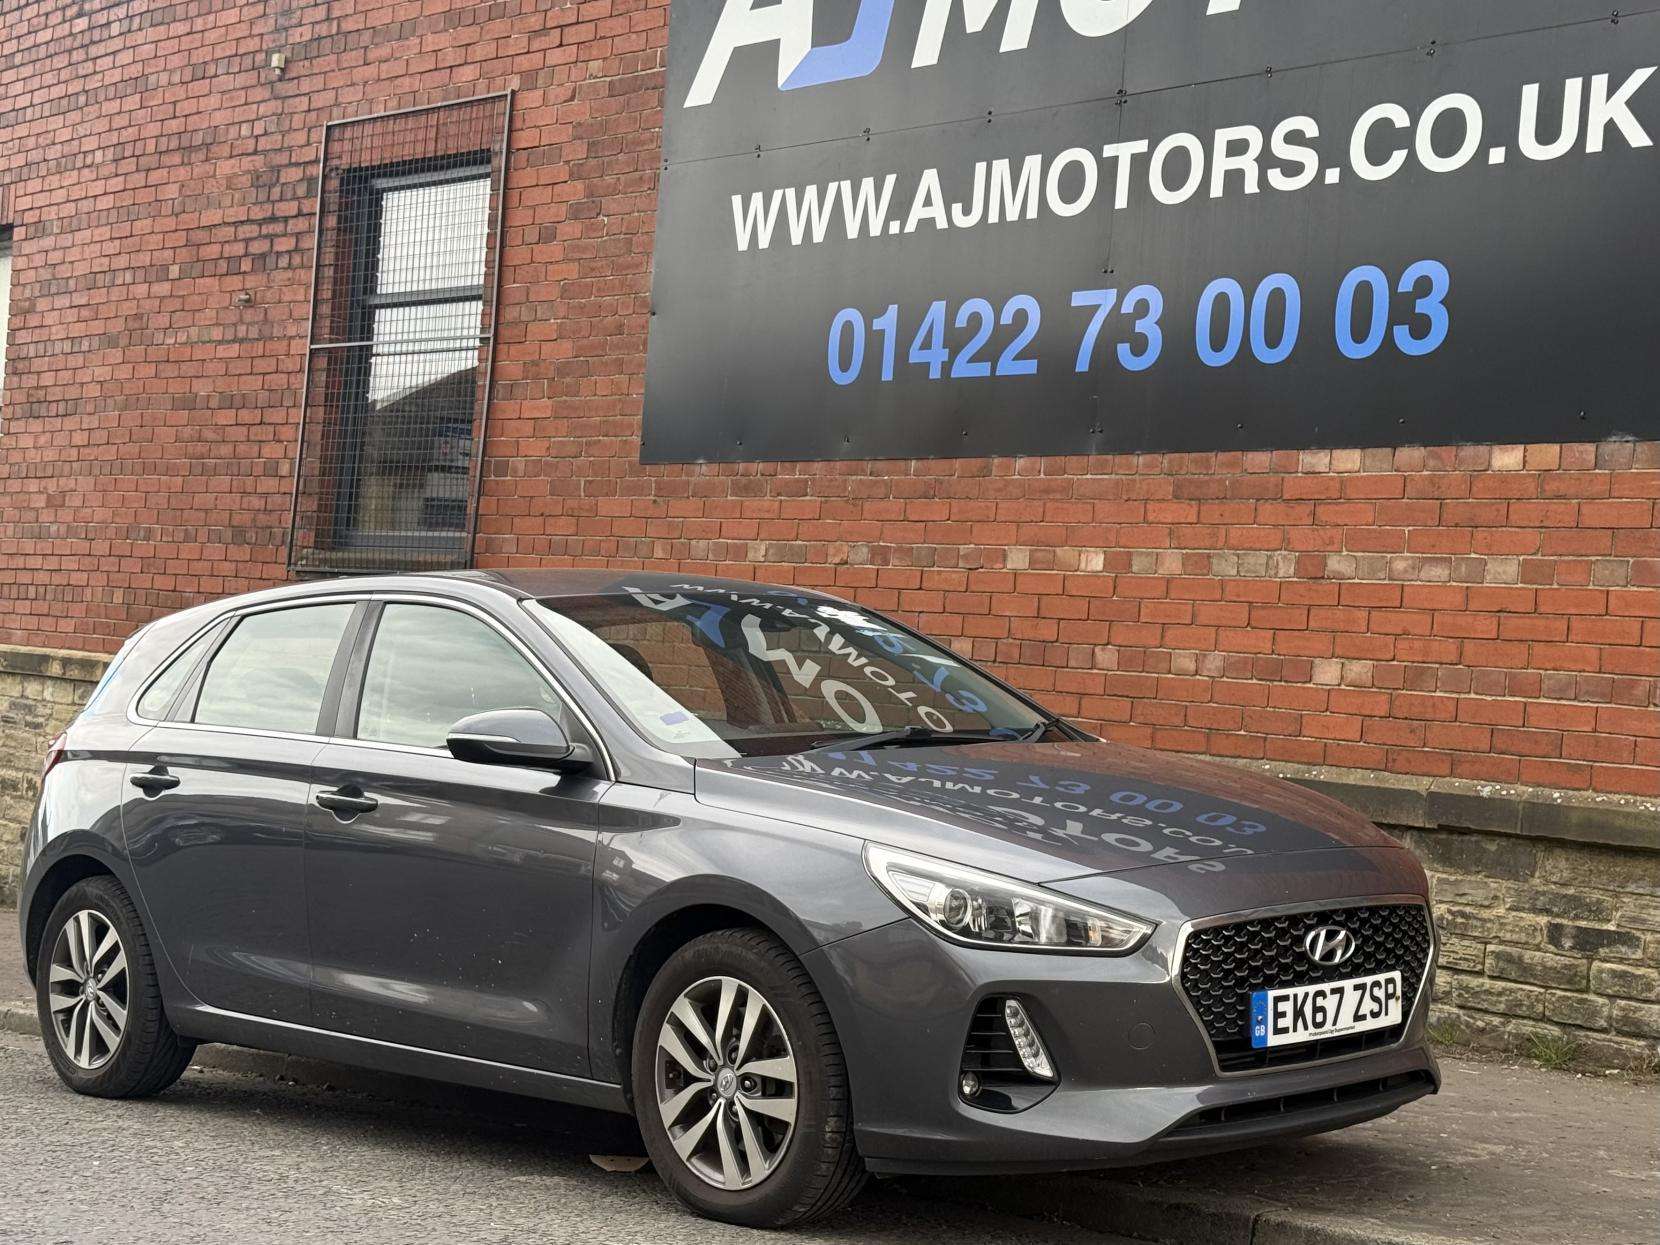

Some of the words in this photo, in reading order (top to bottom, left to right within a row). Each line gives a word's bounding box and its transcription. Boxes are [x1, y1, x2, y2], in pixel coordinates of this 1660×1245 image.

[731, 66, 1658, 251] WWW.AJMOTORS.CO.UK
[827, 294, 1041, 385] 01422
[1071, 284, 1163, 373] 73
[1195, 273, 1301, 367] 00
[1334, 259, 1450, 359] 03
[1255, 1024, 1266, 1037] GB
[1272, 987, 1345, 1036] EK67
[1353, 976, 1397, 1023] ZSP
